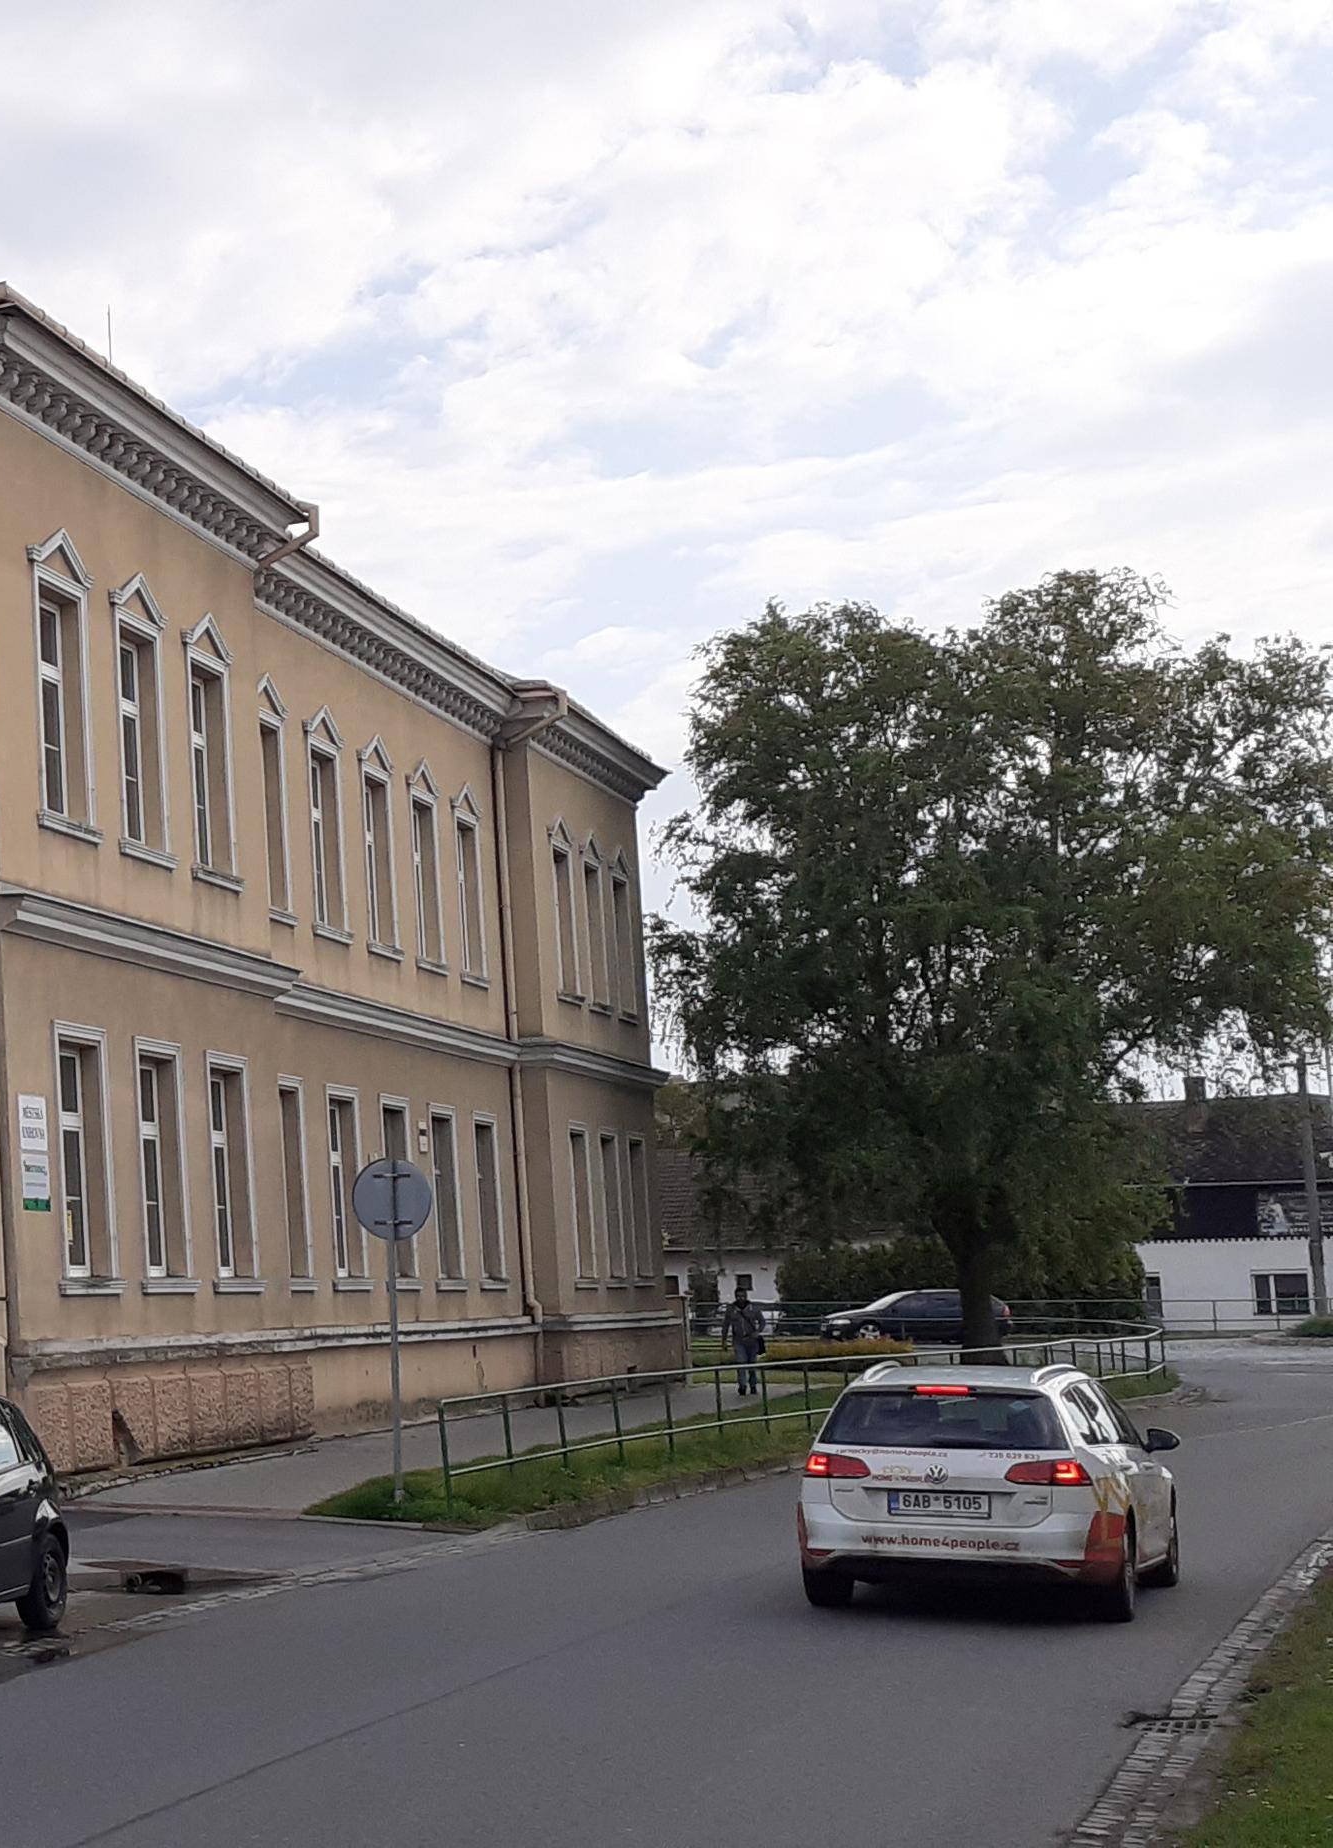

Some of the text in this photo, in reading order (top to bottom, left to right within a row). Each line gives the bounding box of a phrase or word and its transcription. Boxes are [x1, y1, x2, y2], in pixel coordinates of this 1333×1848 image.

[902, 1494, 982, 1511] 6AB 5105
[861, 1534, 1020, 1551] www.home4people.cz
